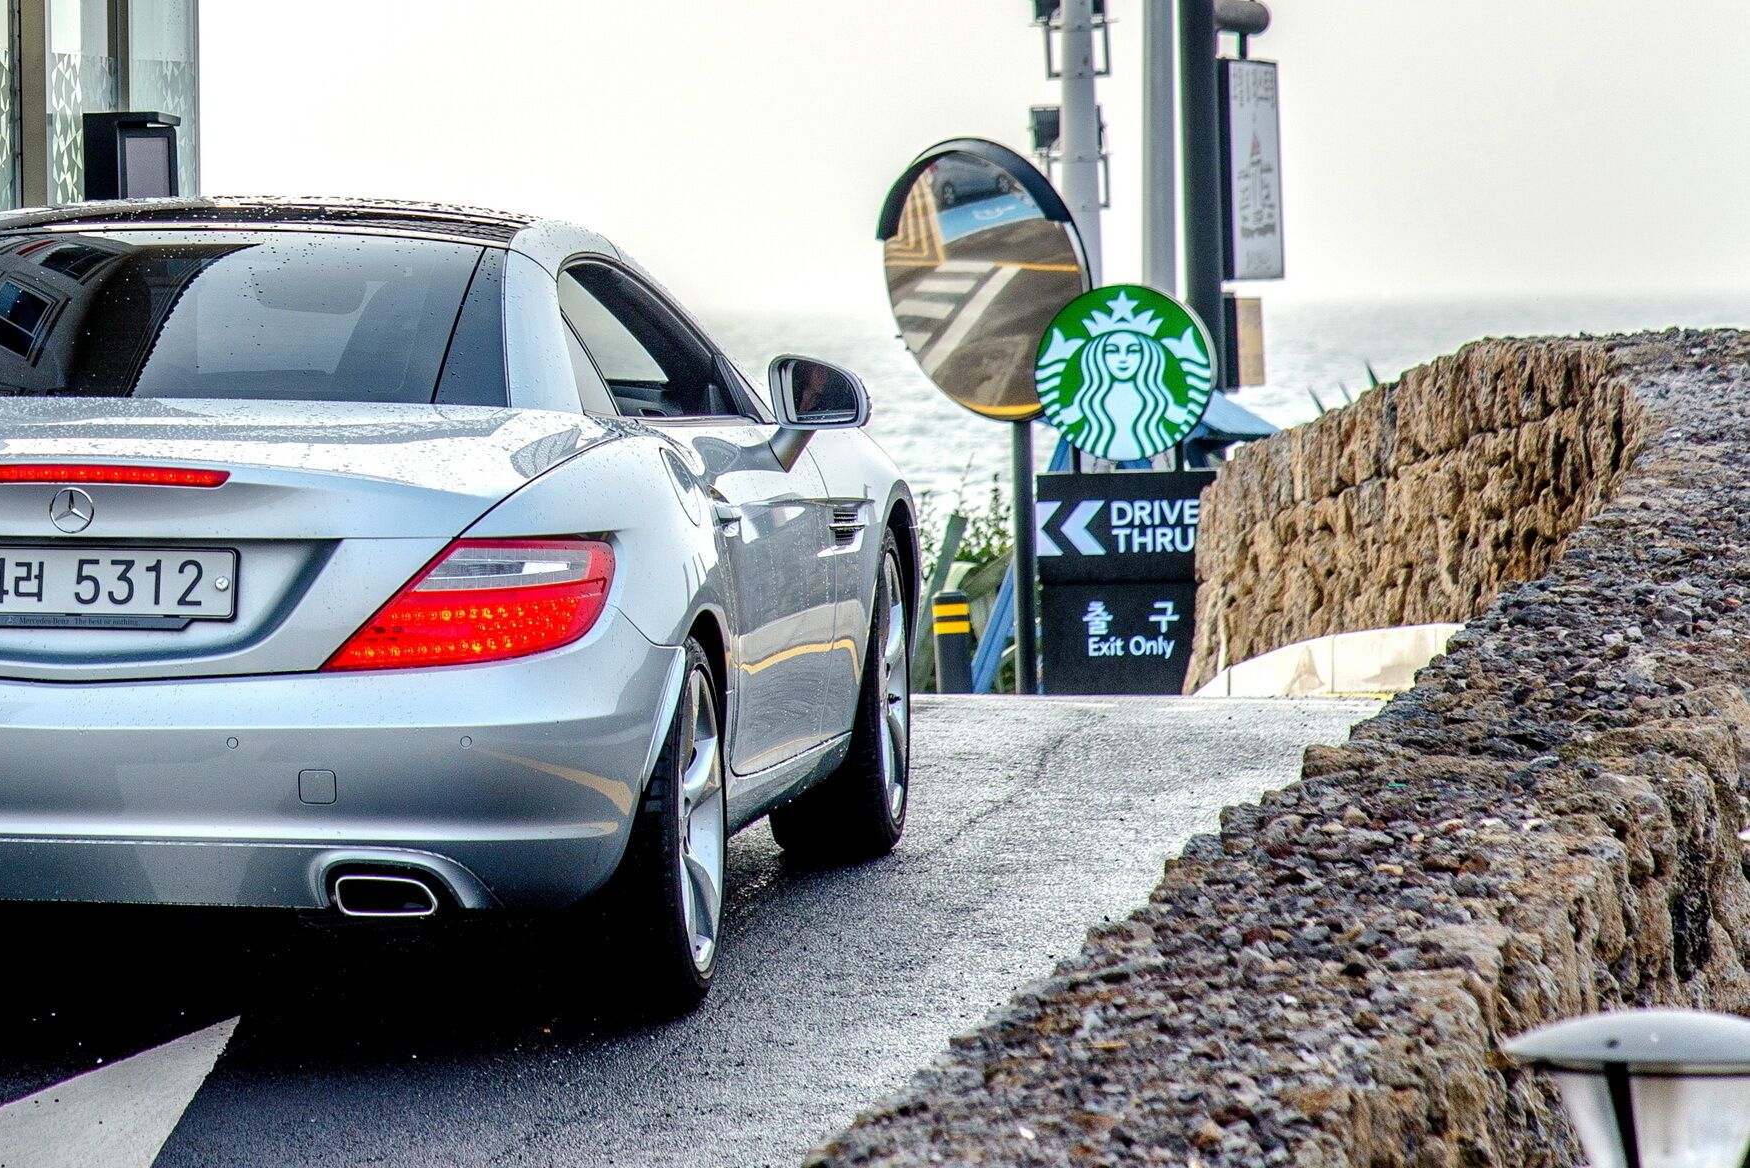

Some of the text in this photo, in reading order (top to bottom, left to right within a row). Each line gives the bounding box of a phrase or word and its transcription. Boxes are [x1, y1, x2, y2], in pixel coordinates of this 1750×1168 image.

[1110, 499, 1200, 527] DRIVE
[1111, 526, 1195, 554] THRU
[73, 558, 204, 606] 5312
[1088, 635, 1176, 660] Exit Only
